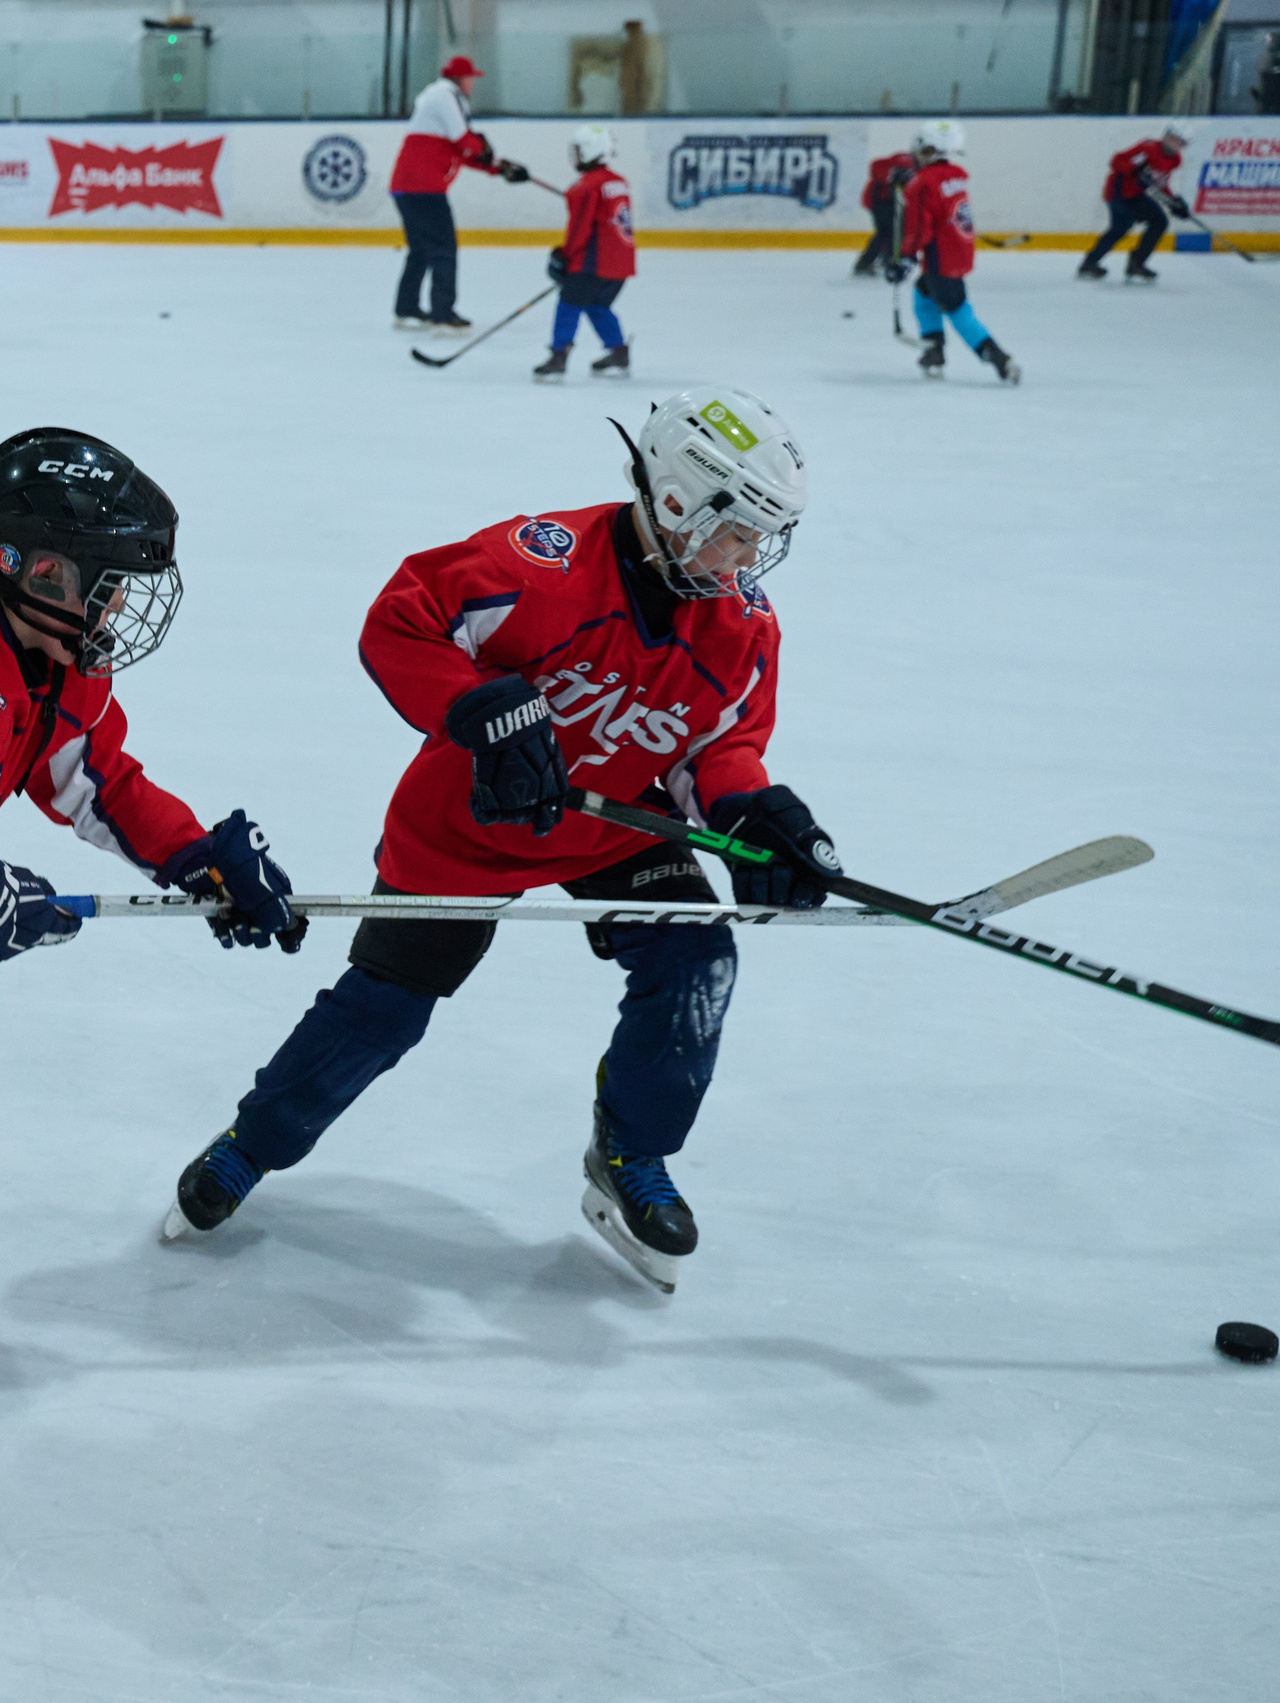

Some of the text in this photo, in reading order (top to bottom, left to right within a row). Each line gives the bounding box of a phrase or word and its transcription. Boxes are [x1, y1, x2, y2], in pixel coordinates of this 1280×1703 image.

[145, 162, 202, 187] Банк
[670, 146, 836, 210] СИБИРЬ
[38, 459, 115, 482] CCM
[527, 524, 558, 557] STEPS
[543, 525, 570, 547] 10
[184, 865, 209, 883] CCM
